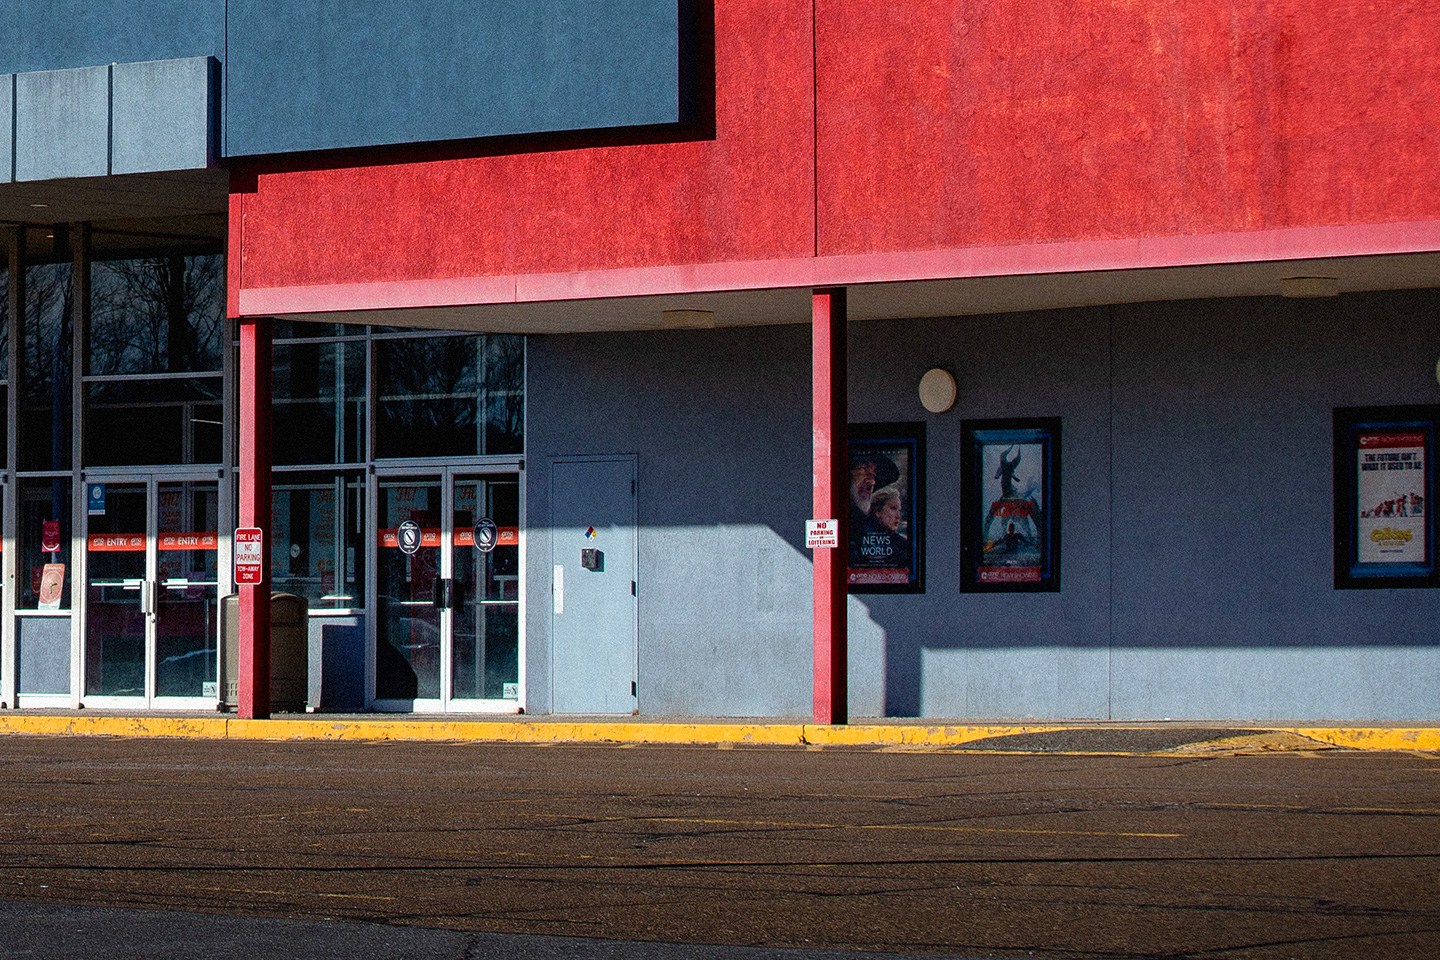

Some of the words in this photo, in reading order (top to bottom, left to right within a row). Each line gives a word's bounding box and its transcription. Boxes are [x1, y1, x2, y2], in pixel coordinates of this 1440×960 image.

[1365, 453, 1376, 462] THE
[1377, 453, 1400, 461] FUTURE
[816, 522, 827, 530] NO
[106, 538, 127, 547] ENTRY
[178, 537, 199, 545] ENTRY
[862, 535, 891, 545] NEWS
[860, 546, 893, 556] WORLD
[237, 553, 260, 561] PARKING
